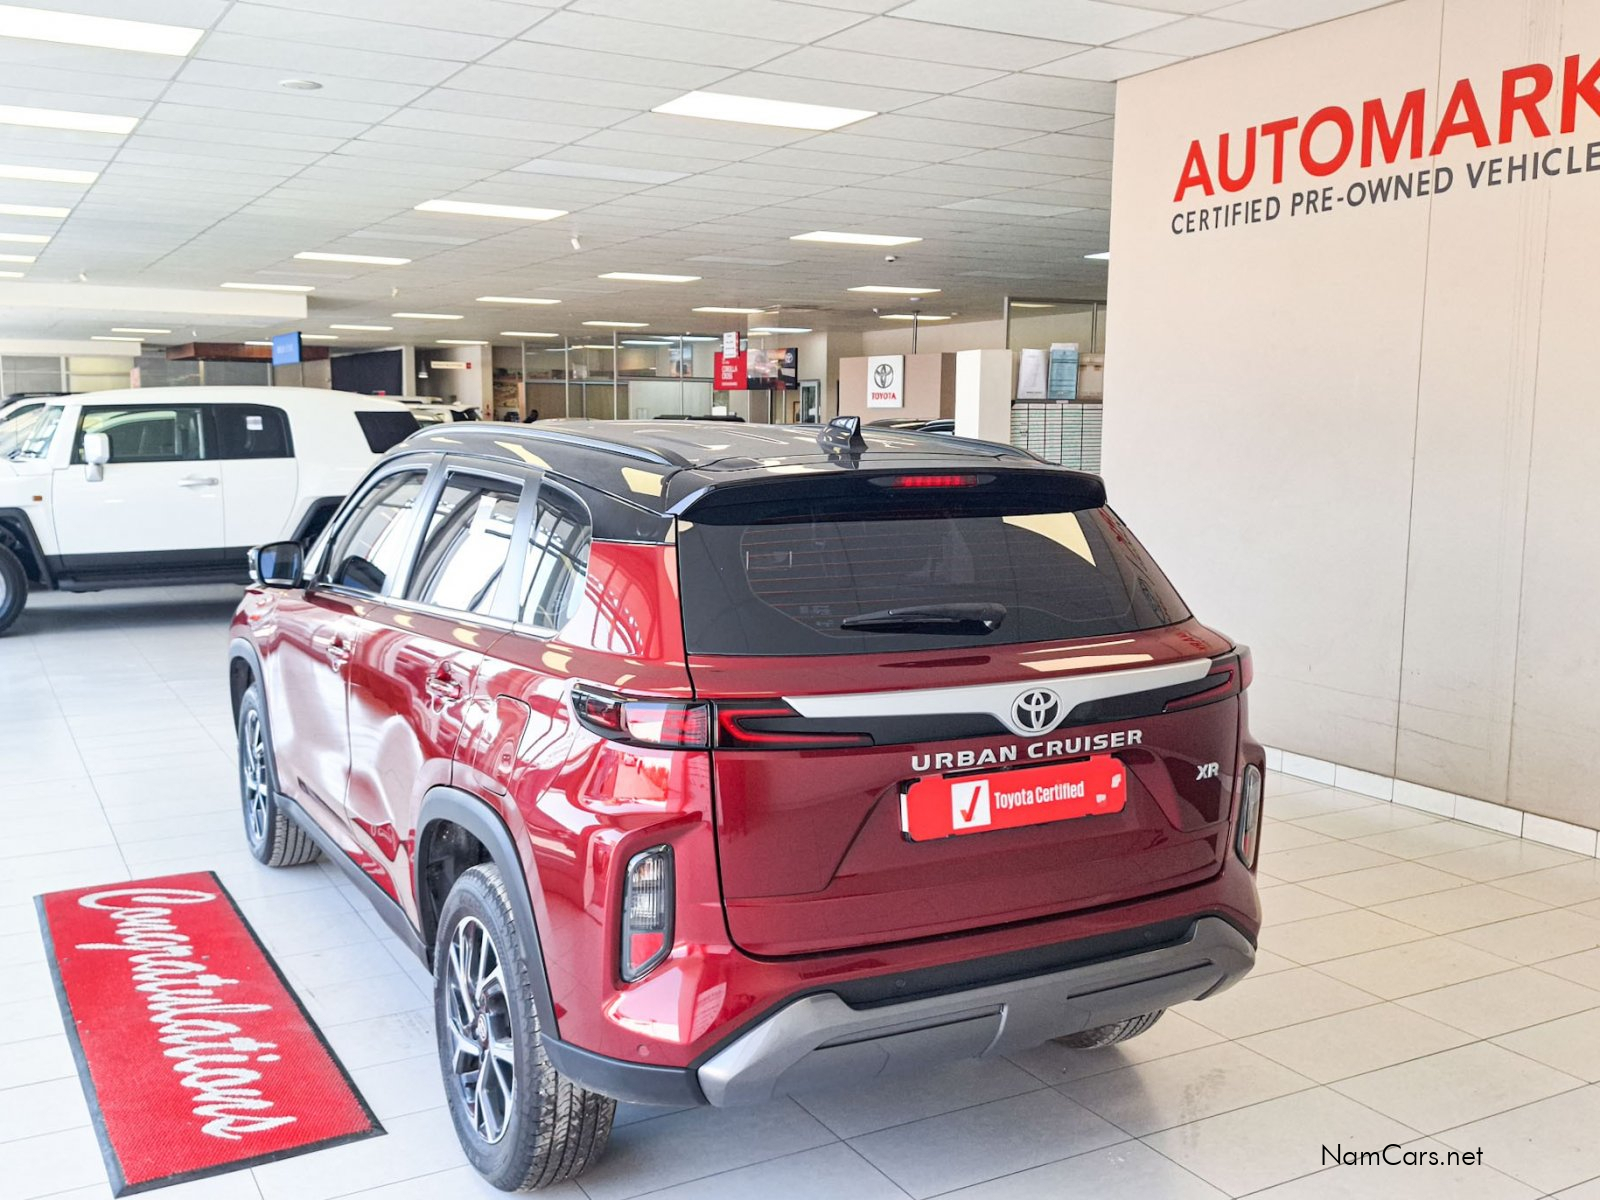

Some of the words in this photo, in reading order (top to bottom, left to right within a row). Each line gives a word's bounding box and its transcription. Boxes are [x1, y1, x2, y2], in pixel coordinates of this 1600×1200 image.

[1173, 54, 1600, 202] AUTOMARK
[1171, 196, 1281, 235] CERTIFIED
[1290, 166, 1454, 217] PRE-OWNED
[871, 392, 897, 400] TOYOTA
[911, 745, 1017, 772] URBAN
[1027, 729, 1143, 759] CRUISER
[1195, 762, 1219, 780] XR
[994, 788, 1034, 809] Toyota
[1035, 781, 1085, 805] Certified
[75, 888, 297, 1140] Congratulations
